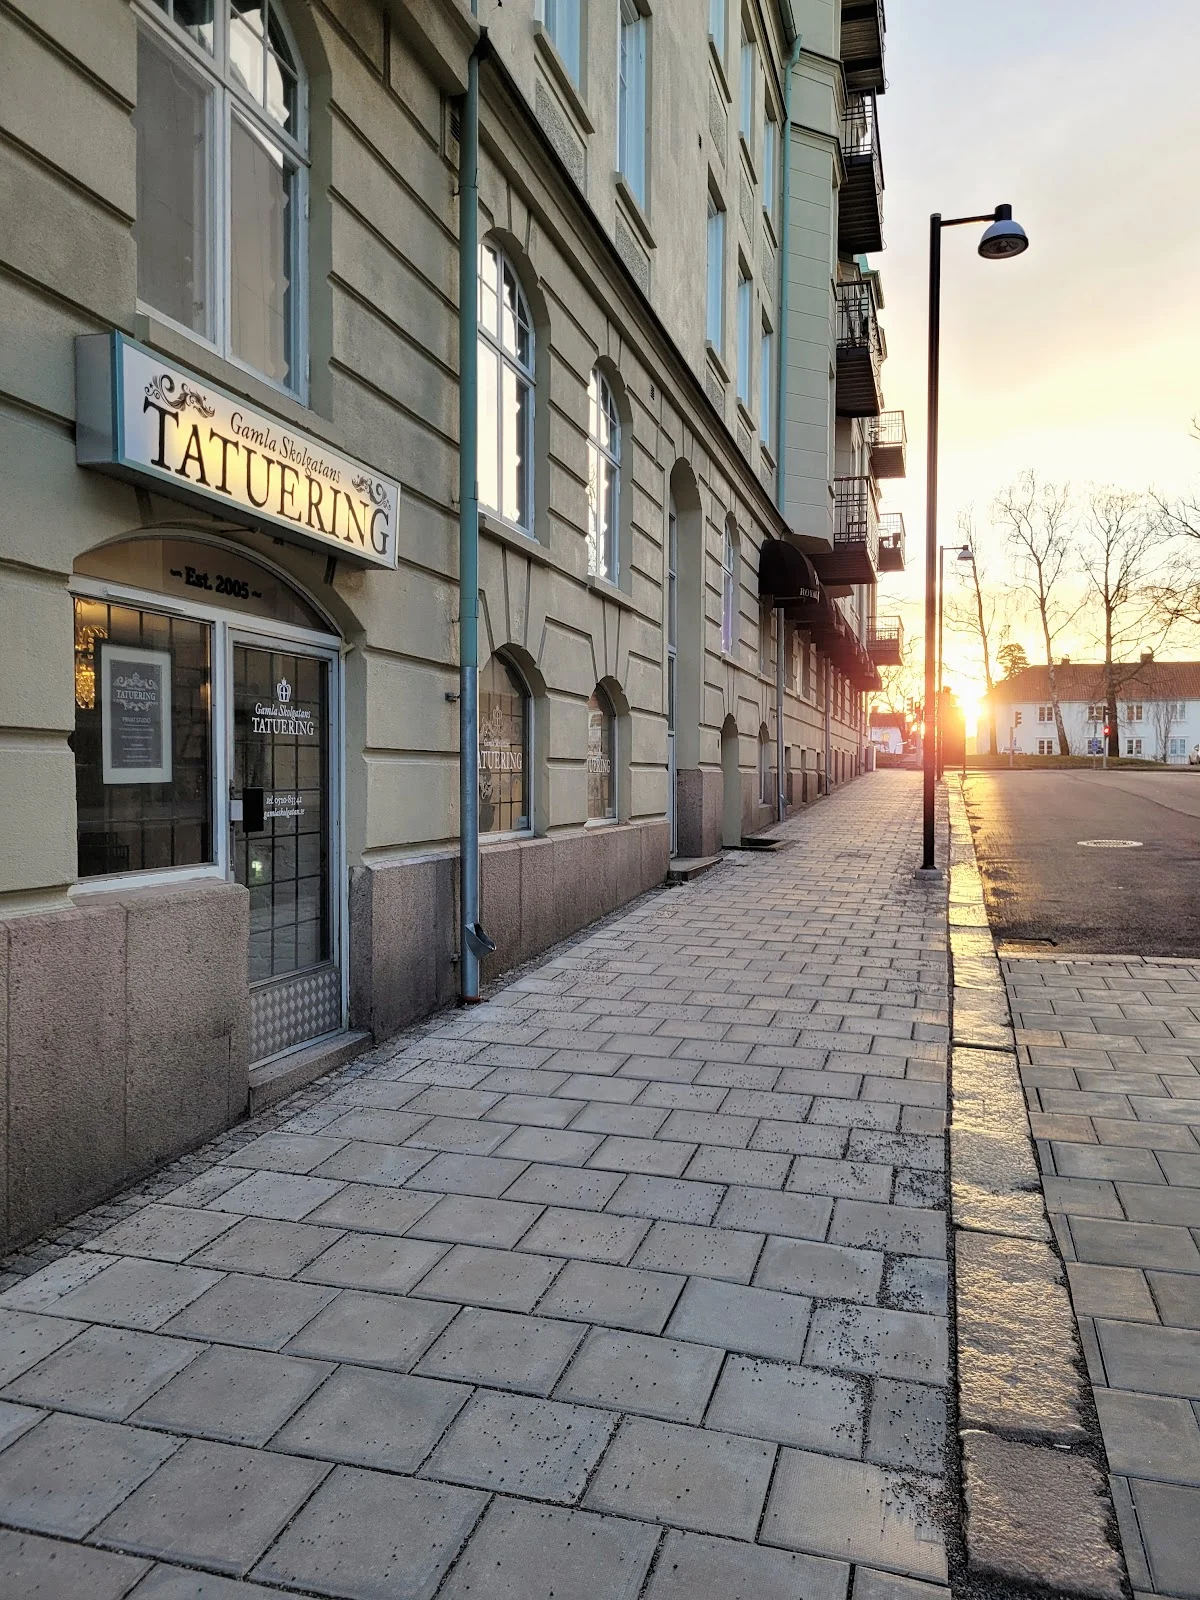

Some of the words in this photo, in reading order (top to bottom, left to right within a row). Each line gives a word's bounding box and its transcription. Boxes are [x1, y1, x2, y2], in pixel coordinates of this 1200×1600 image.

[230, 411, 277, 453] Gamla
[279, 436, 342, 484] Skolgatans
[143, 396, 390, 555] TATUERING
[184, 566, 213, 589] Est.
[215, 574, 249, 600] 2005
[116, 690, 156, 701] TATUERING
[255, 703, 277, 716] Gamla
[278, 704, 311, 721] Skolgatans
[252, 717, 314, 735] TATUERING
[478, 750, 522, 770] ATUERING
[586, 758, 611, 773] TUERING
